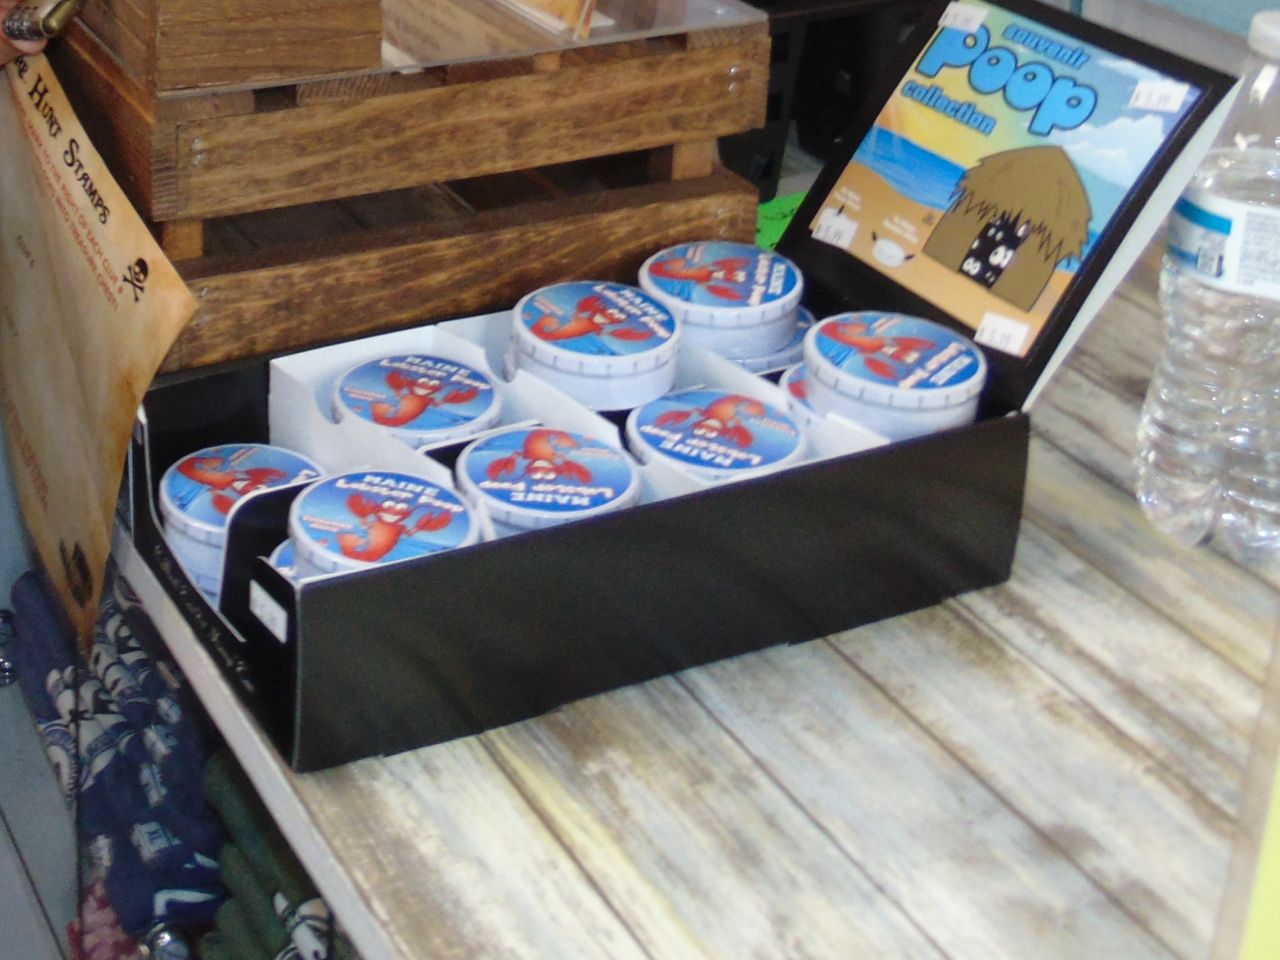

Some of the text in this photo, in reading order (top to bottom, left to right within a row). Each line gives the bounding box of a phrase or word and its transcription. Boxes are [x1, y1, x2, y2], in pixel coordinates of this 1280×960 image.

[1002, 24, 1090, 69] souvenir
[901, 80, 997, 136] collection
[364, 475, 440, 496] MAINE
[510, 492, 591, 506] MAINE
